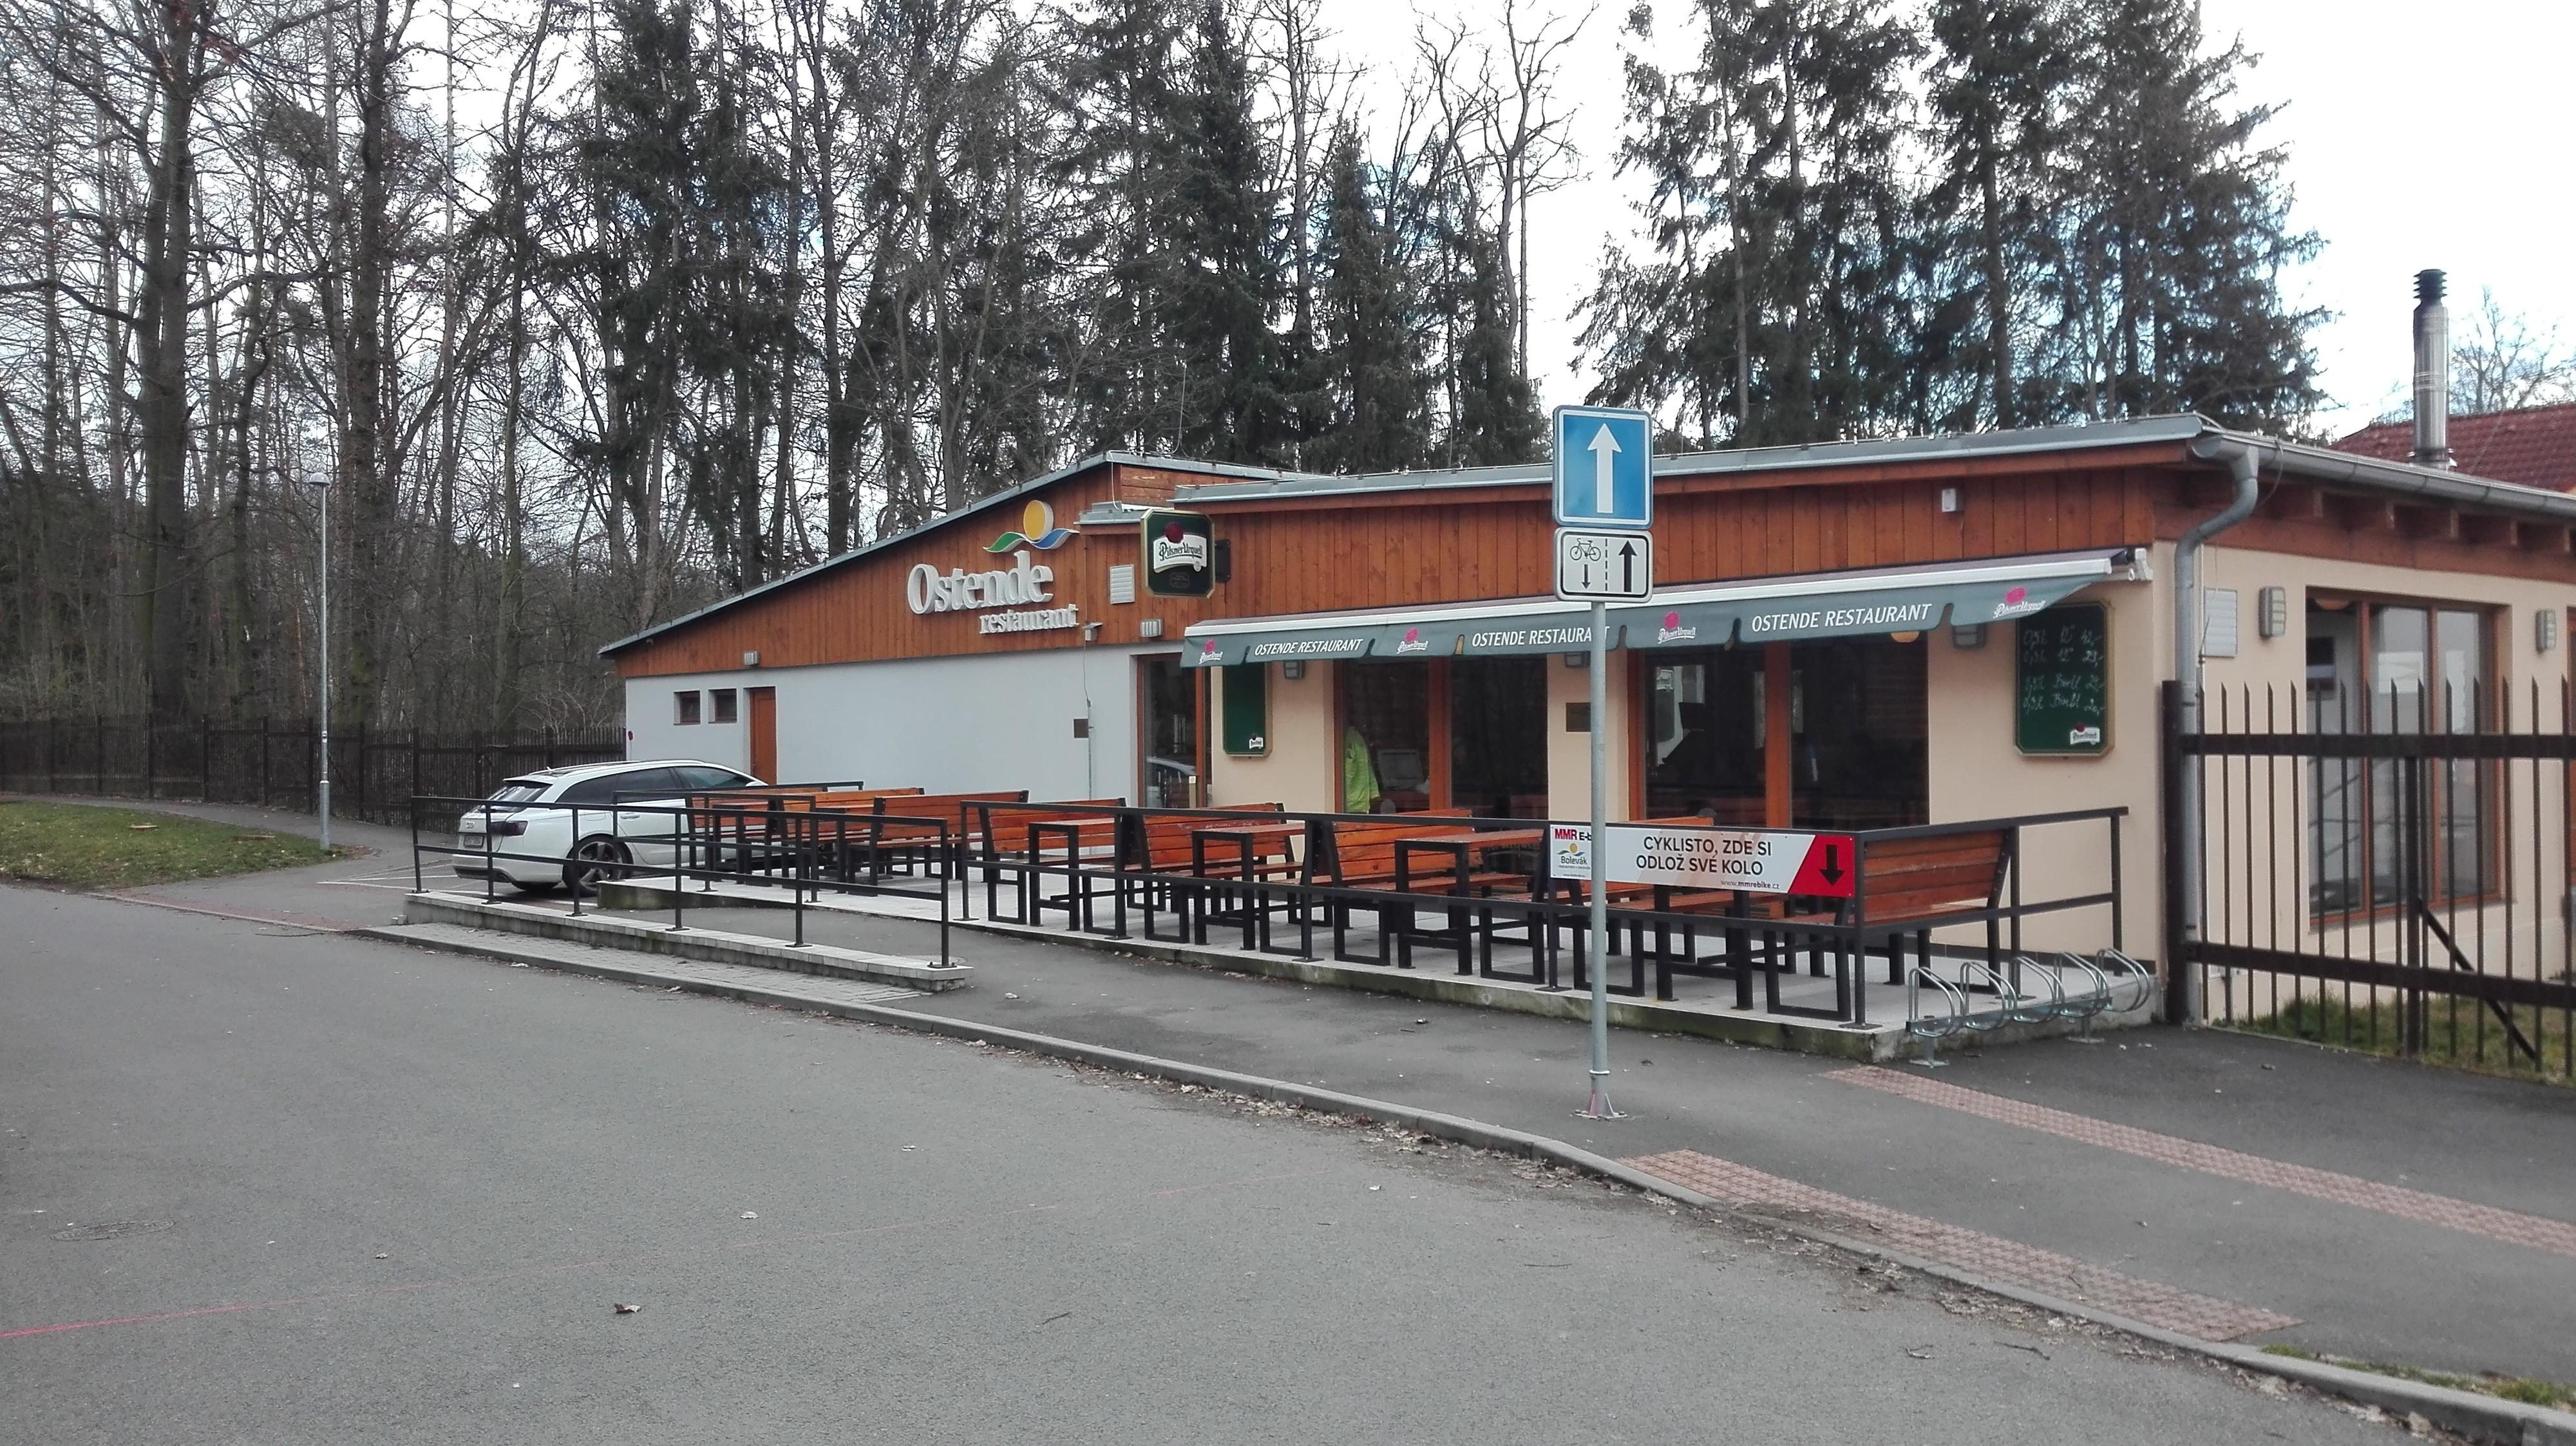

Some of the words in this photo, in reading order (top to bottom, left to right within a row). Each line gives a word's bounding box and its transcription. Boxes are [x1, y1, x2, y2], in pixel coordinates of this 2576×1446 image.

[1159, 542, 1185, 561] Pilsner
[1183, 542, 1203, 559] Urquell
[907, 550, 1054, 614] Ostende
[980, 604, 1079, 634] restaurant
[1752, 612, 1821, 632] OSTENDE
[1825, 603, 1931, 626] RESTAURANT
[1472, 630, 1526, 647] OSTENDE
[1530, 626, 1610, 644] RESTAURAT
[1255, 643, 1299, 656] OSTENDE
[1298, 639, 1364, 653] RESTAURANT
[1555, 829, 1577, 840] MMR
[1643, 836, 1718, 855] CYKLISTO,
[1723, 840, 1753, 855] ZDE
[1757, 841, 1772, 856] SI
[1561, 856, 1587, 865] Bolevák
[1636, 853, 1685, 871] ODLOŽ
[1689, 855, 1718, 873] SVÉ
[1722, 859, 1763, 876] KOLO
[1720, 880, 1780, 890] www.mmrebike.cz
